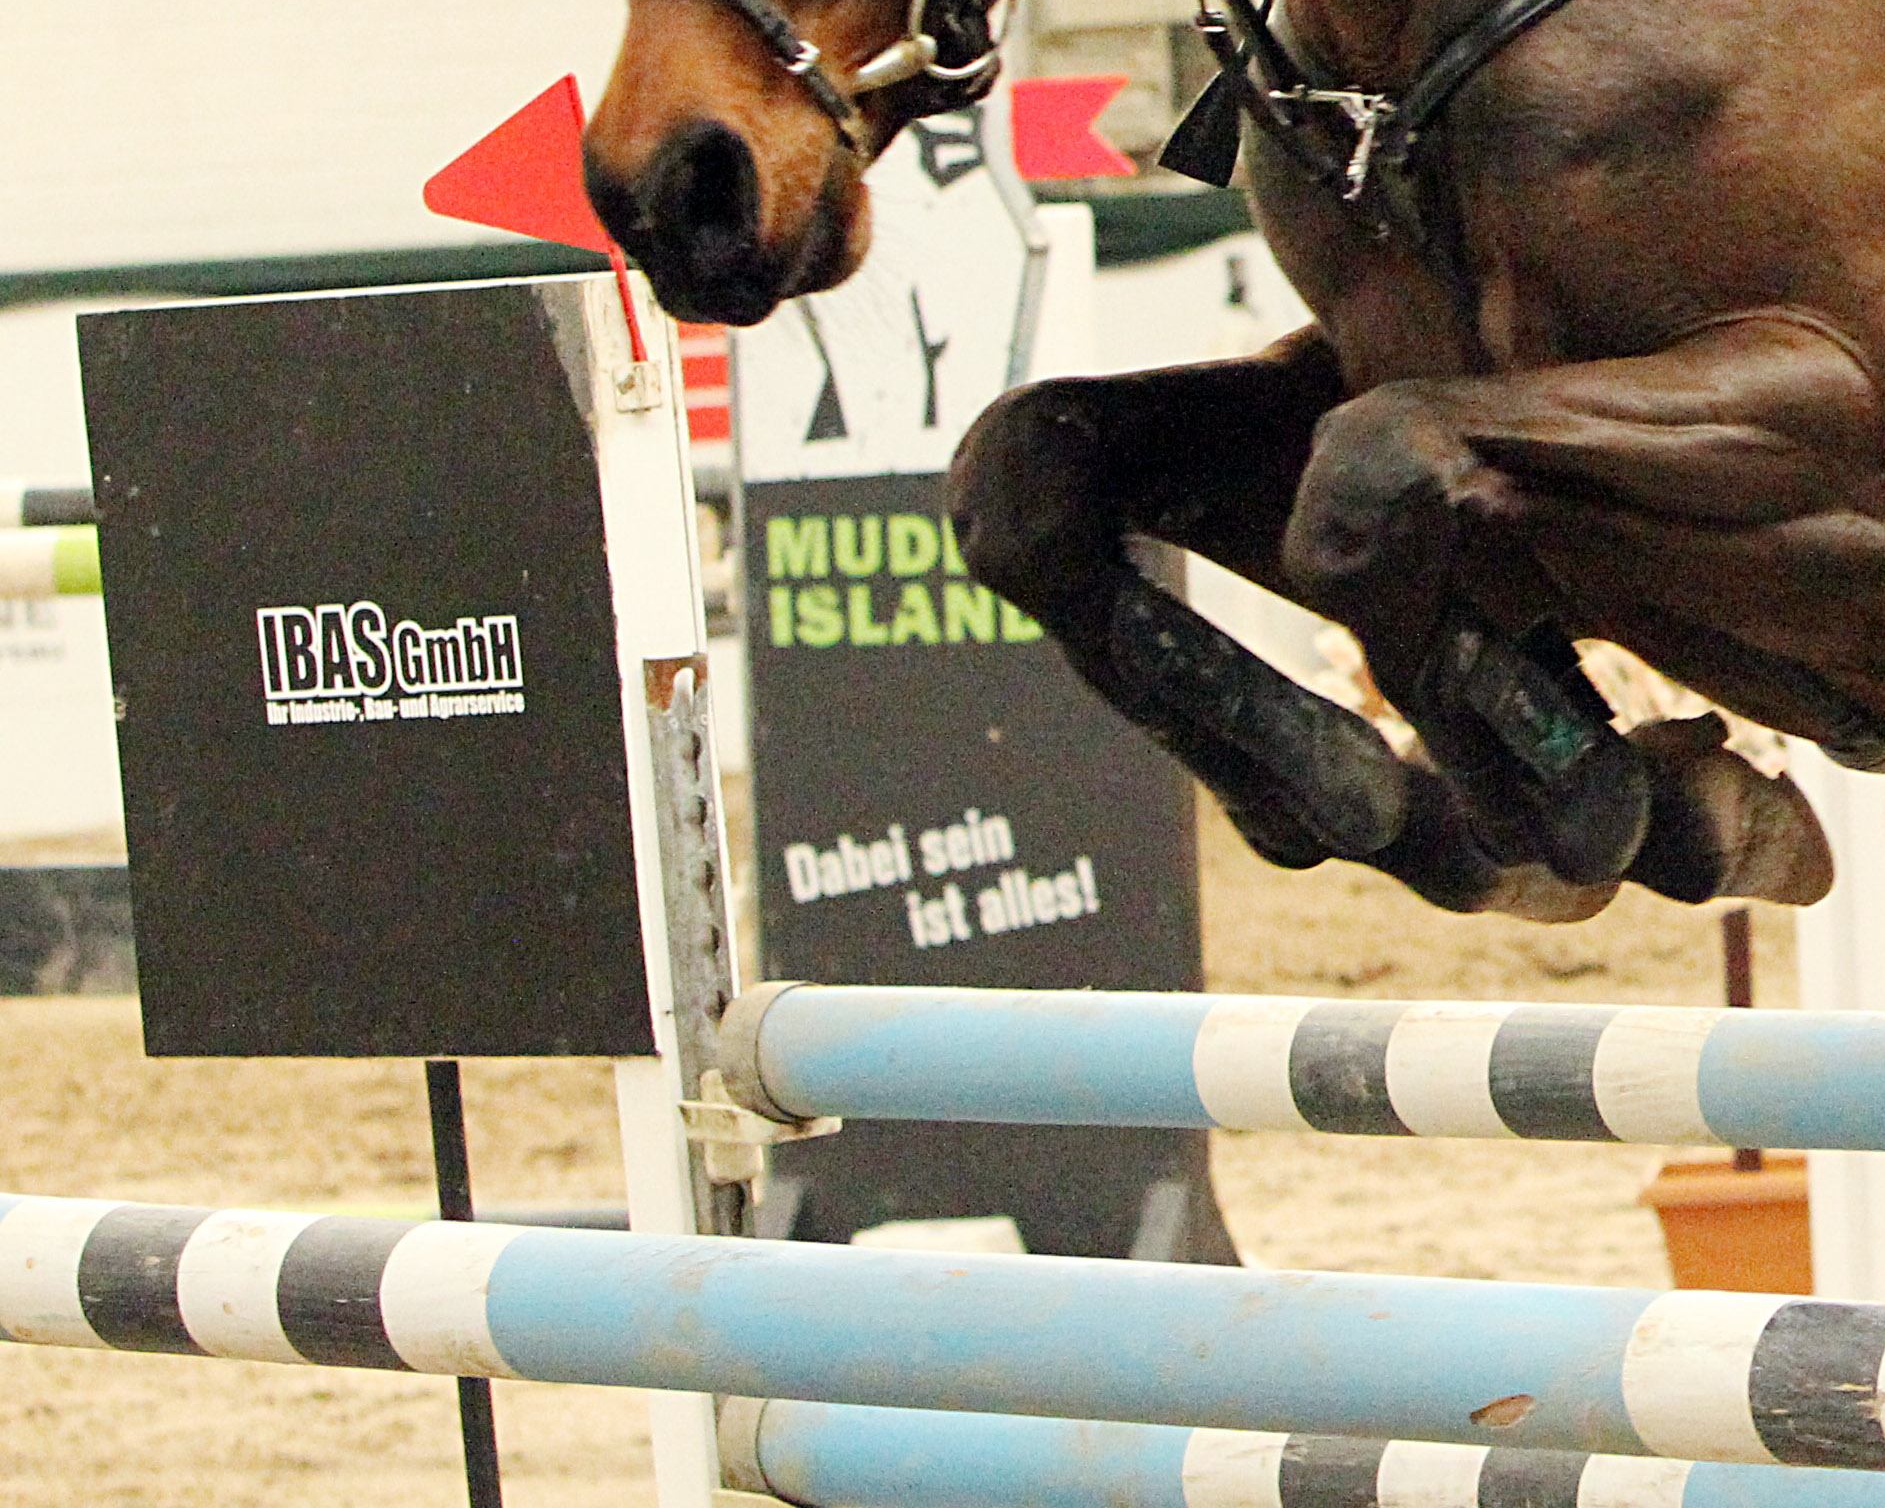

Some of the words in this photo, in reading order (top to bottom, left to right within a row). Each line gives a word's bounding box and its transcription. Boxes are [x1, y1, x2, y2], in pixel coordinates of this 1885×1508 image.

[257, 601, 393, 700] IBAS
[393, 616, 523, 694] GmbH
[399, 693, 429, 719] und
[429, 690, 526, 720] Agrarservice
[784, 823, 913, 903] Dabei
[919, 807, 1015, 876] sein
[906, 883, 972, 949] ist
[977, 854, 1100, 935] alles!
